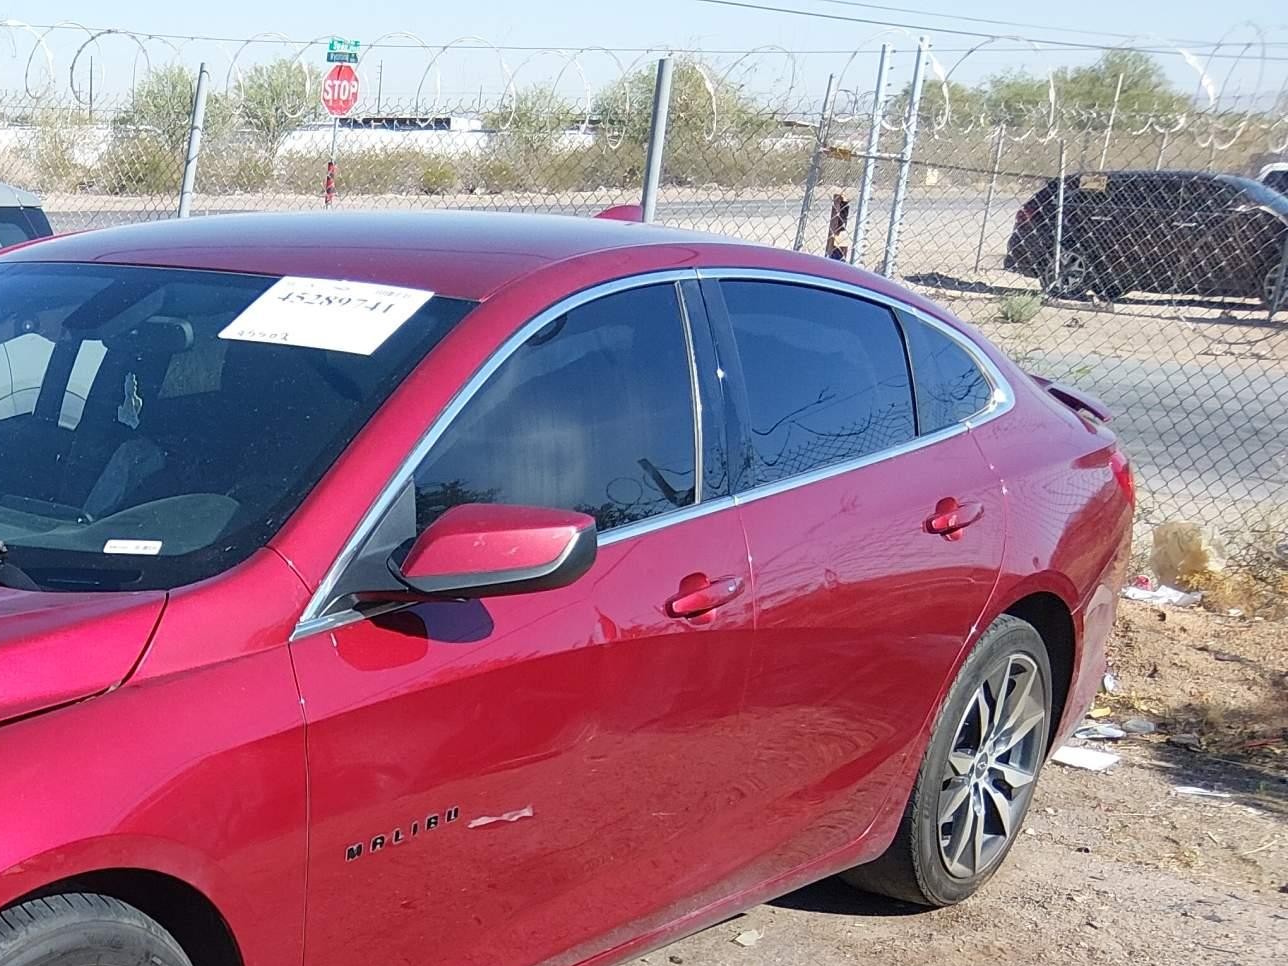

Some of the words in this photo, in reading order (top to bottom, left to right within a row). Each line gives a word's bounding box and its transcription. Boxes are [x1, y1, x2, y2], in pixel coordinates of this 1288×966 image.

[324, 79, 358, 101] STOP
[277, 291, 395, 314] 45289741
[345, 806, 460, 862] MALIBU
